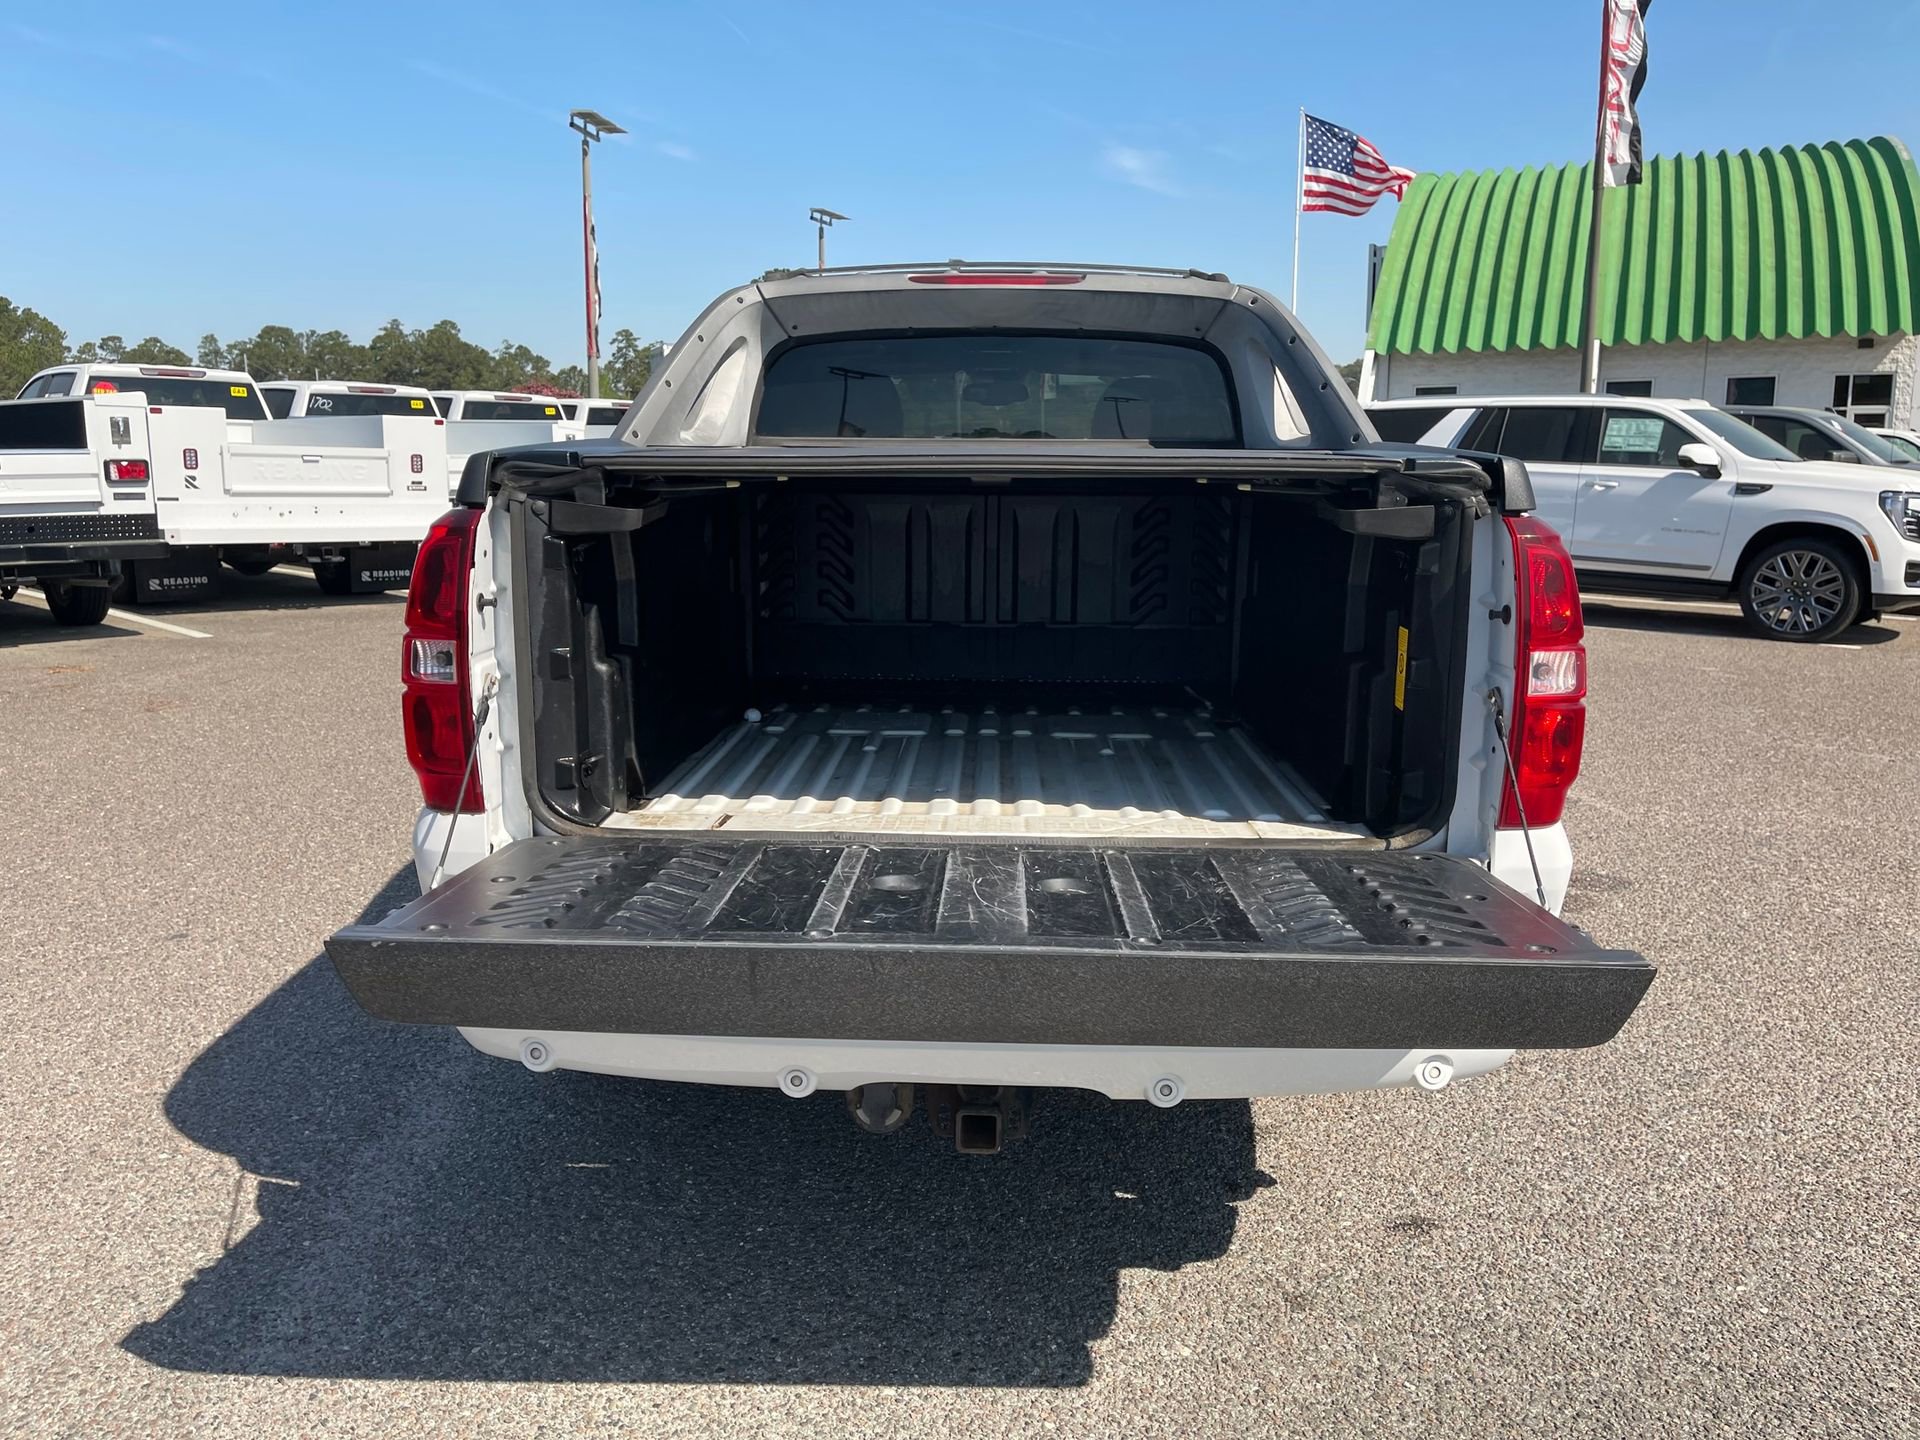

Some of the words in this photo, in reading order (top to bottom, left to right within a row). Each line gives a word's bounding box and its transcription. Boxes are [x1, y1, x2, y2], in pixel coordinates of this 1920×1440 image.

[309, 395, 333, 412] 1702
[372, 569, 410, 578] READING
[162, 576, 209, 586] READING
